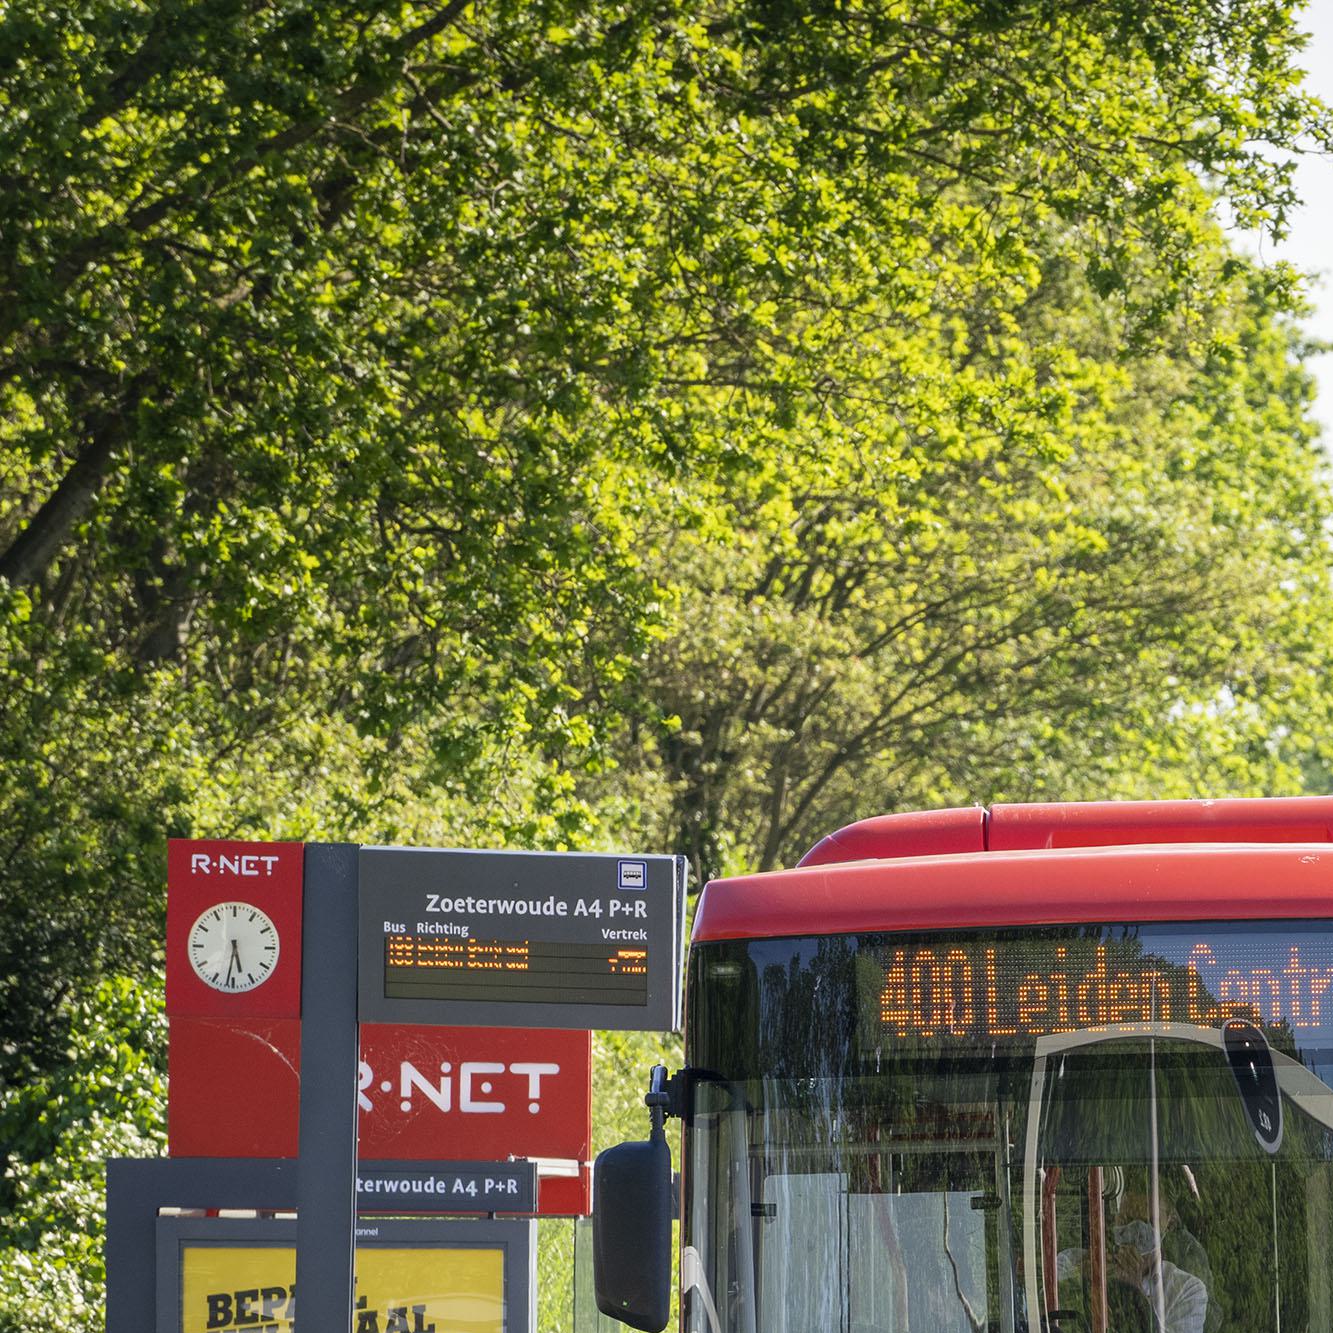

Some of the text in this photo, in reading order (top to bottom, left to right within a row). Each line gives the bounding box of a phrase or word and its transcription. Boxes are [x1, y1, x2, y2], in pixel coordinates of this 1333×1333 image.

[425, 894, 647, 918] Zoeterwoude A4 P+R
[383, 920, 469, 938] Bus Richting
[601, 928, 648, 940] Vertrek
[879, 950, 971, 1036] 400
[986, 946, 1170, 1034] Leiden
[356, 1176, 519, 1197] terwoude A4 P+R
